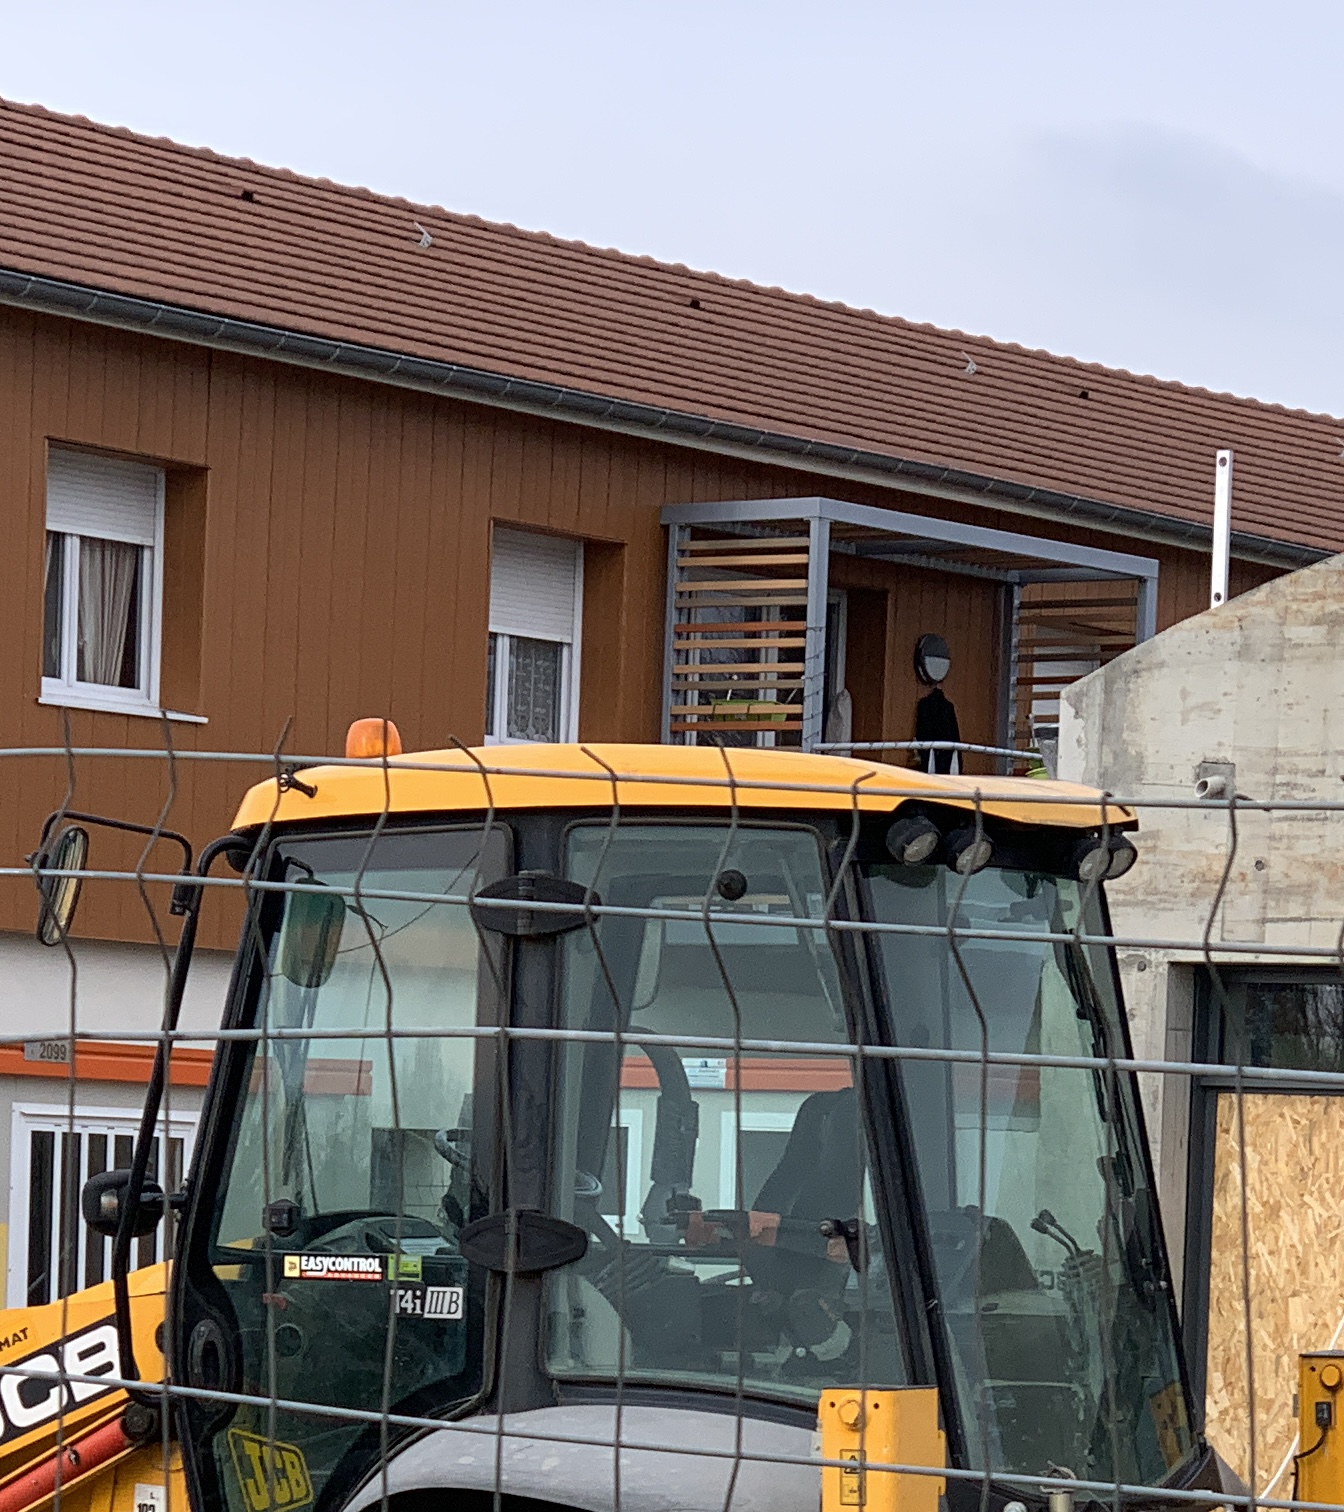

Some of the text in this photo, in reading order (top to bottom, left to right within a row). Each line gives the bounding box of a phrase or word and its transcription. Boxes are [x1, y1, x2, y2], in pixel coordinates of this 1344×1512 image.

[39, 1042, 67, 1060] 2099
[301, 1255, 382, 1274] EASYCONTROL
[390, 1289, 423, 1315] T4i
[243, 1439, 307, 1511] JCB
